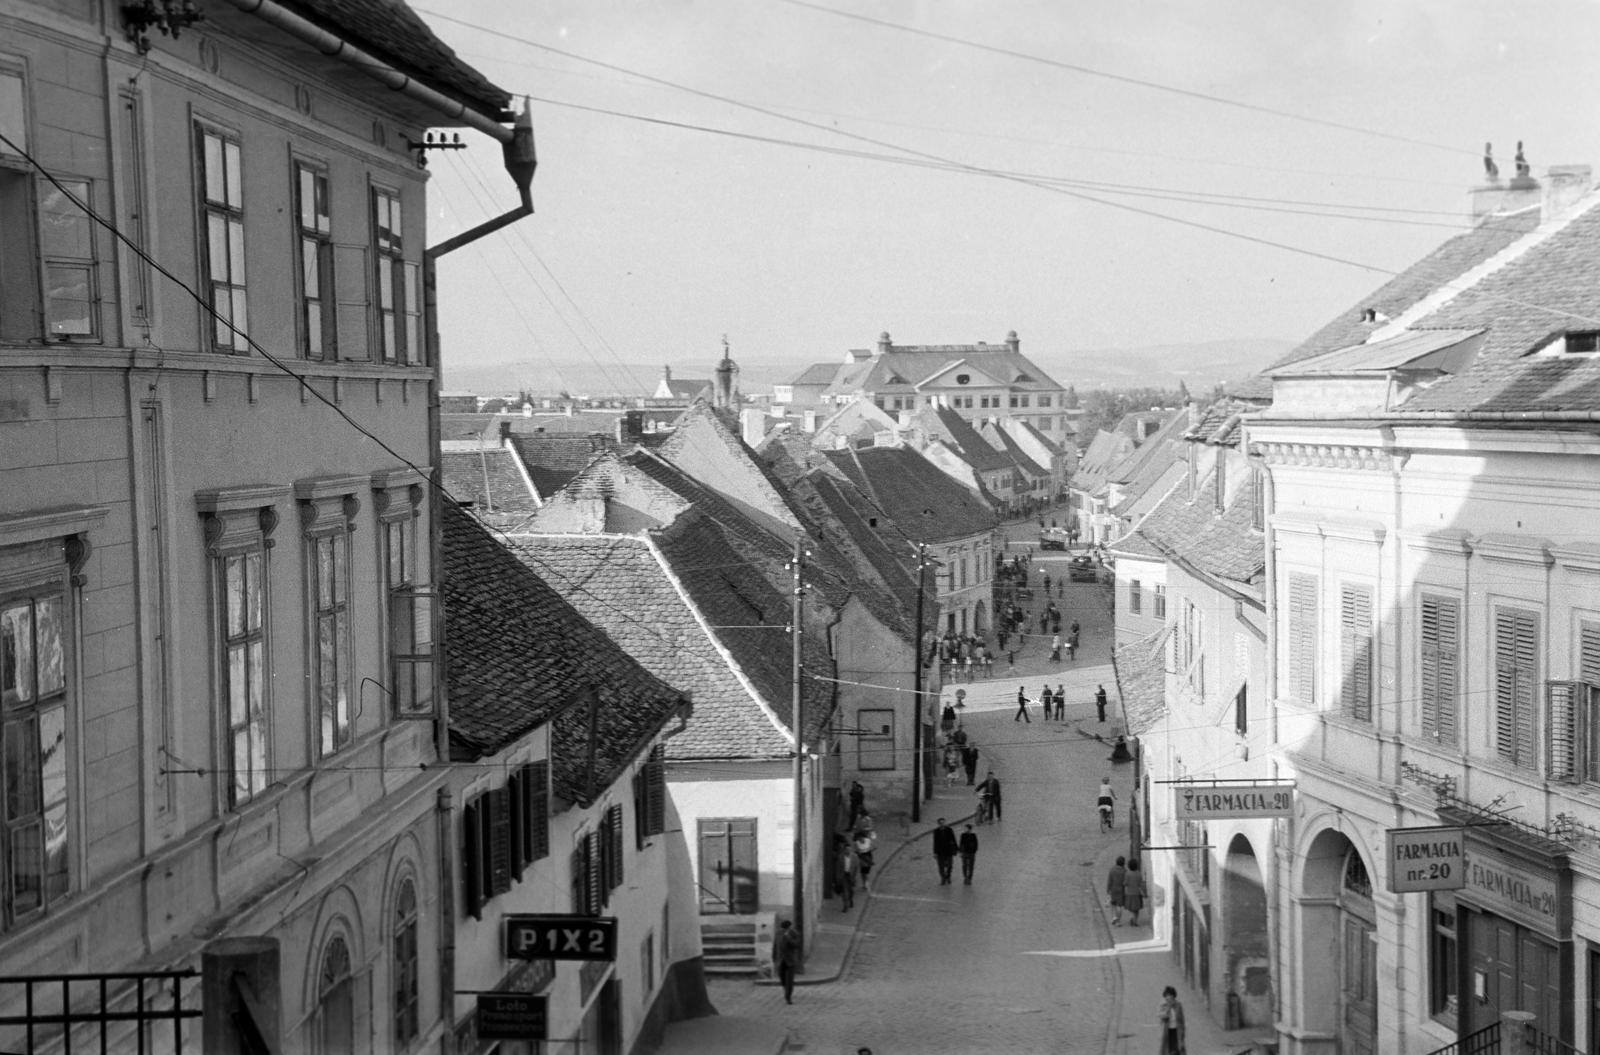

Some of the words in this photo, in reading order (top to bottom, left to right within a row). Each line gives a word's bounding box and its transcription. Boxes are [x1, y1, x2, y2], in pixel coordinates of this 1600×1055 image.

[1195, 793, 1266, 811] FARMACIA
[1273, 792, 1290, 810] 20
[1396, 841, 1460, 860] FARMACIA
[1473, 864, 1533, 909] FARMACIA
[1542, 891, 1556, 917] 20
[495, 999, 528, 1011] Loto
